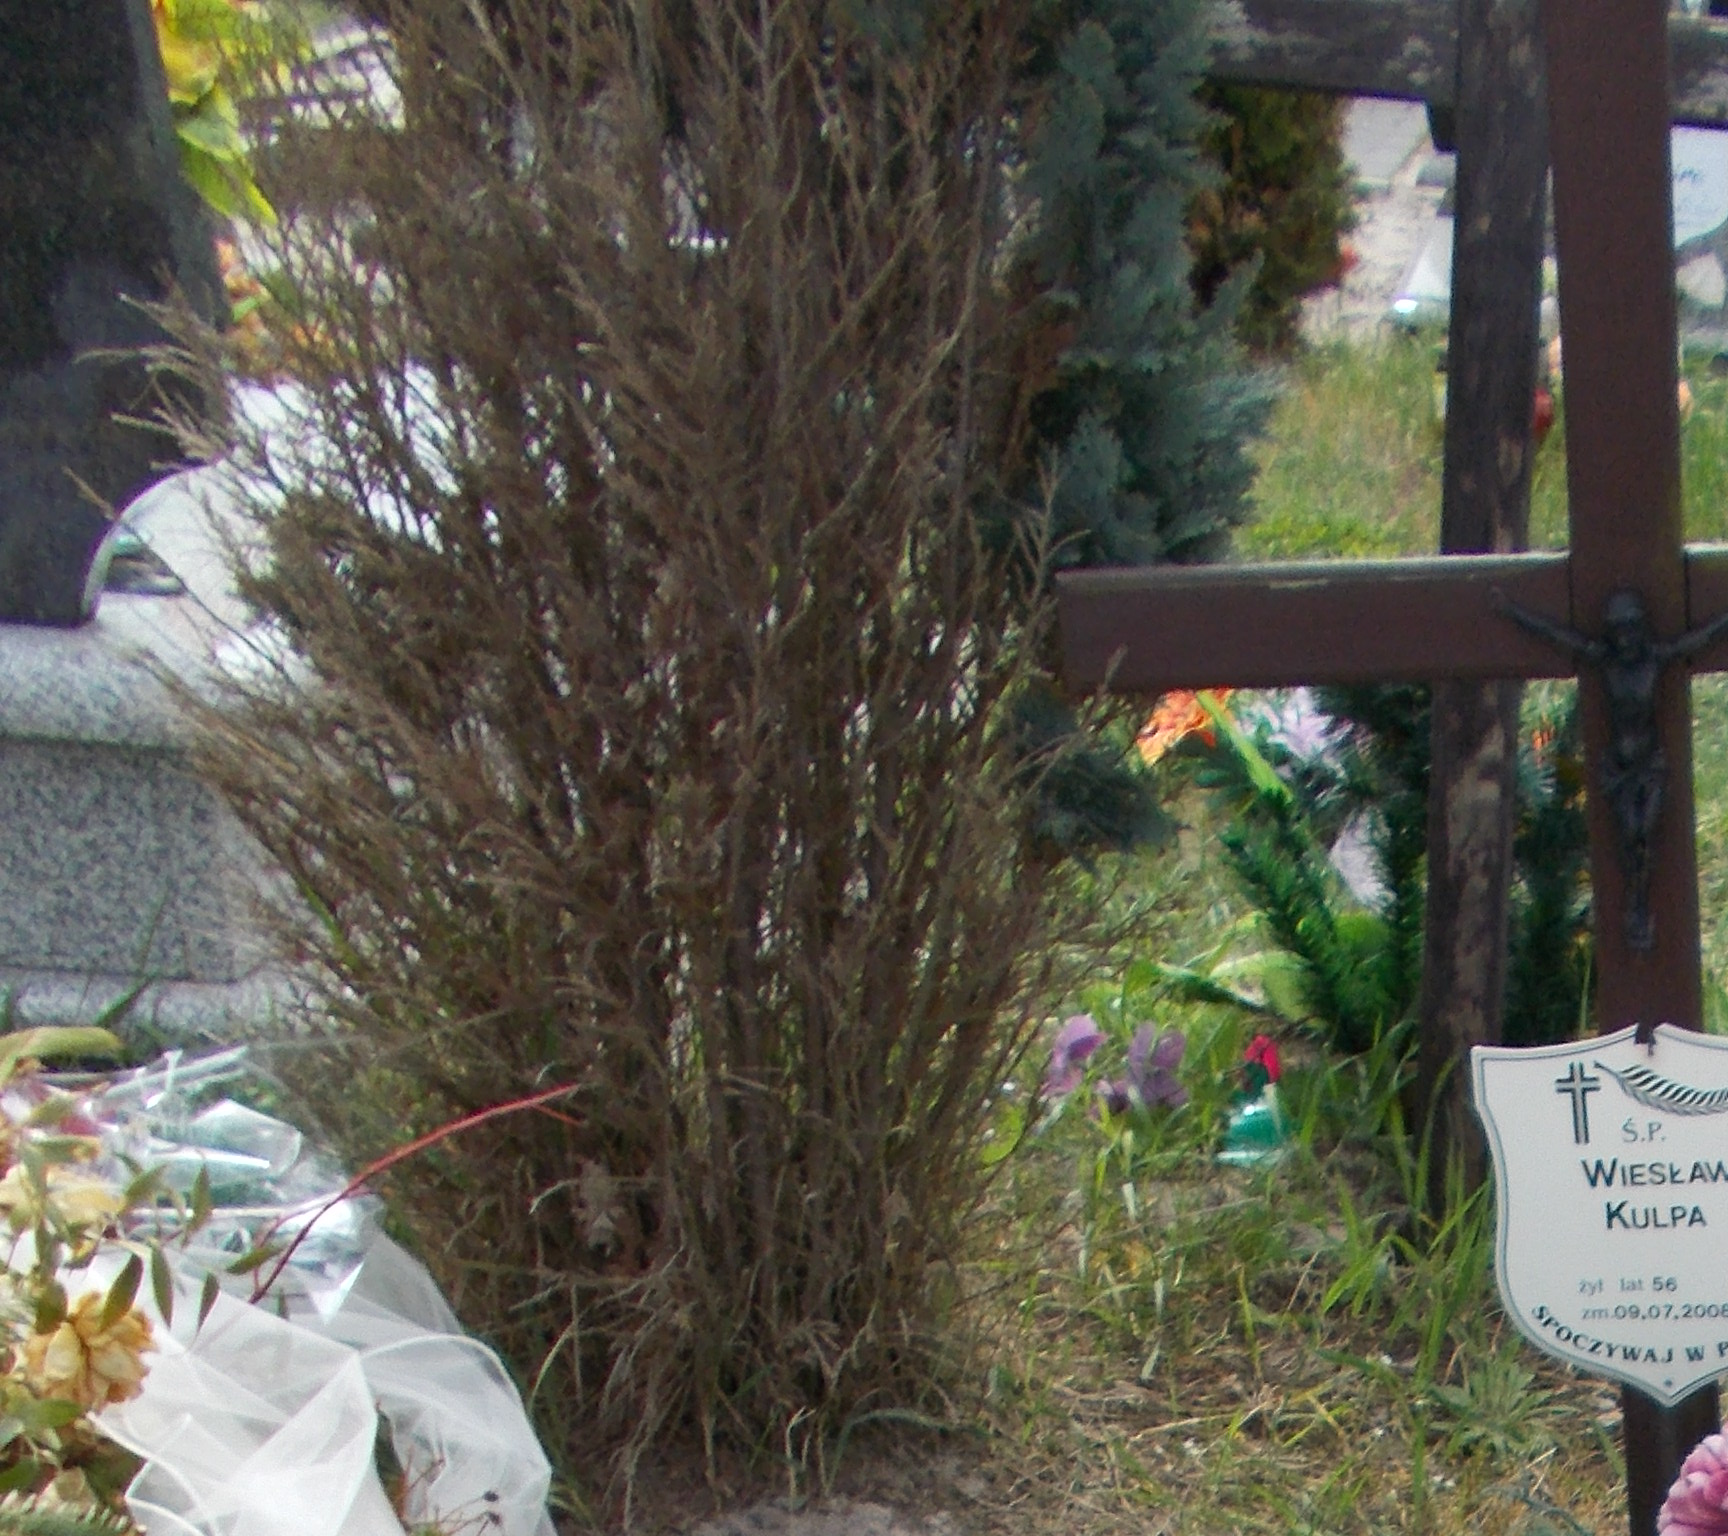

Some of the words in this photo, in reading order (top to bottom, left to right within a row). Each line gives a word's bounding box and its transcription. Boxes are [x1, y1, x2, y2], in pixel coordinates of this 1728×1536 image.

[1605, 1200, 1708, 1230] KULPA
[1620, 1276, 1645, 1293] lat
[1652, 1276, 1678, 1293] 56
[1530, 1303, 1675, 1364] SPOCZYWAJ
[1686, 1344, 1706, 1362] W
